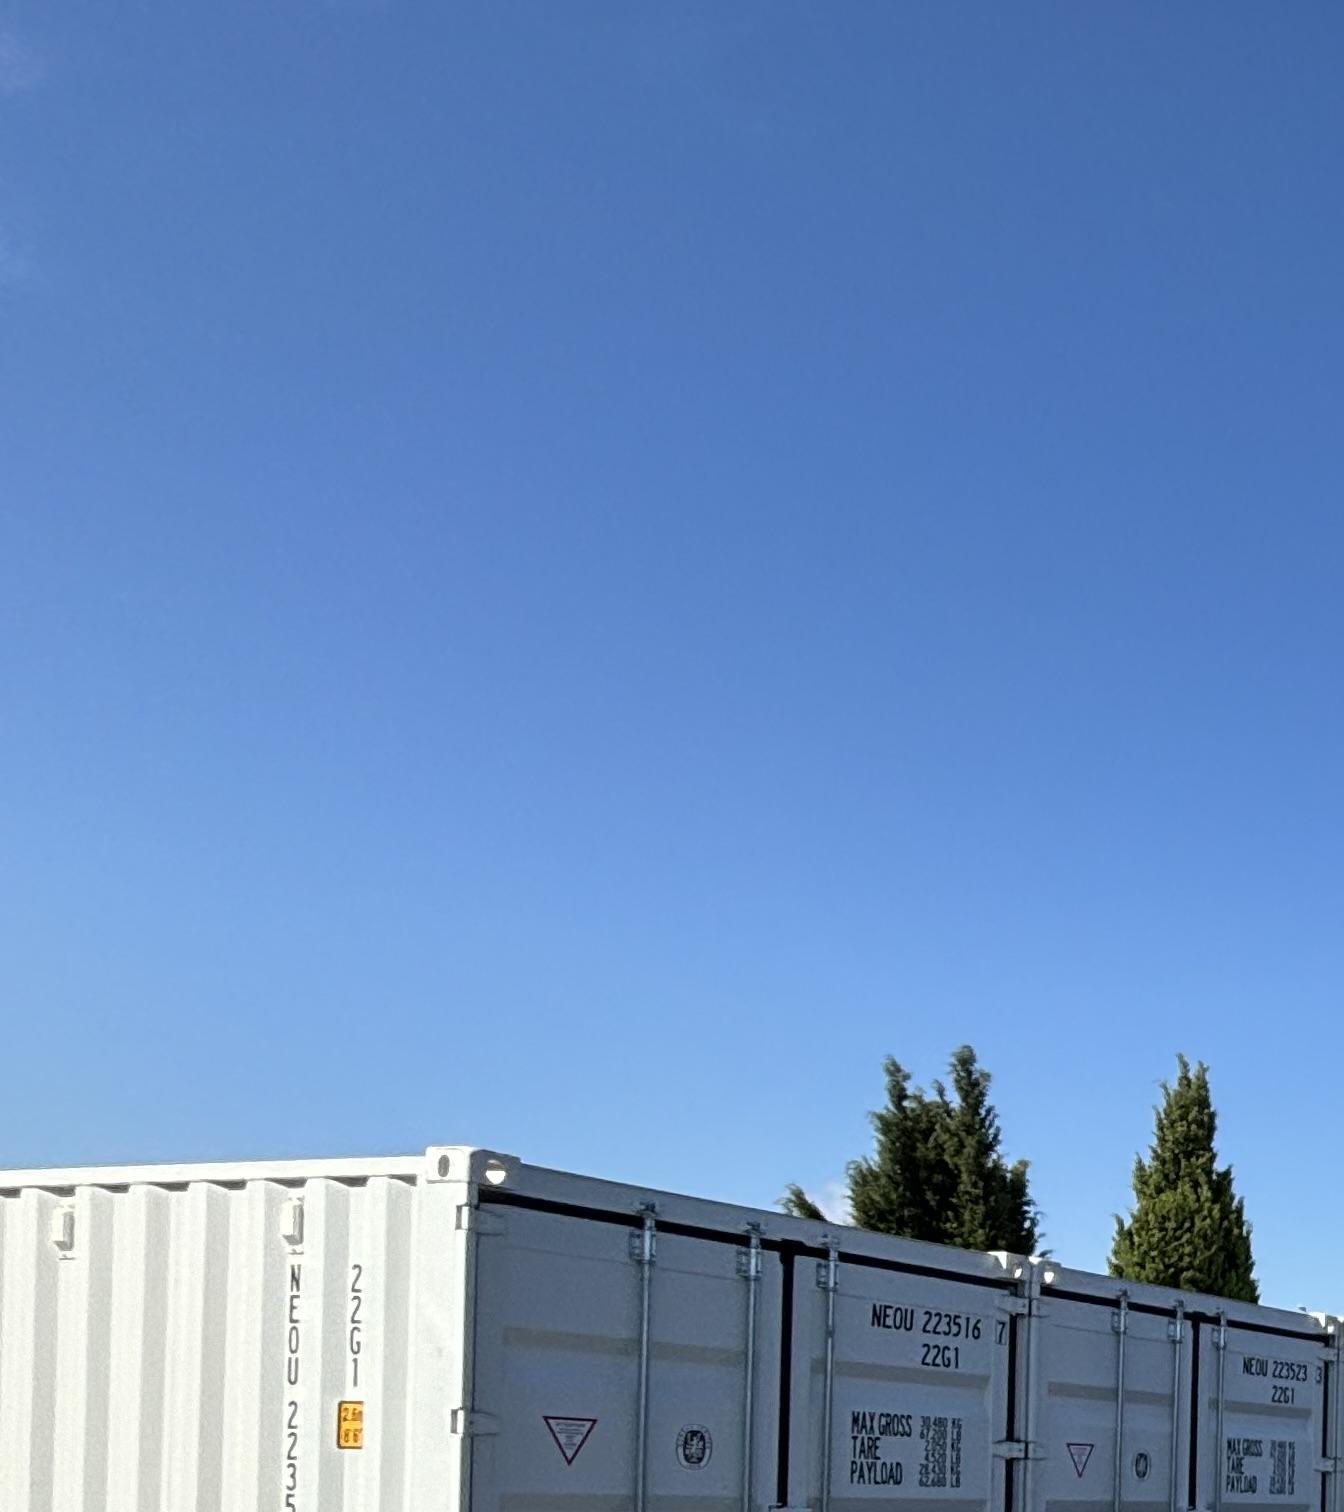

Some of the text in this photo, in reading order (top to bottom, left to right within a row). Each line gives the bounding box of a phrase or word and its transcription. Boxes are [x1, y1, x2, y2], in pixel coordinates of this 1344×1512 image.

[287, 1264, 301, 1385] NEOU
[350, 1264, 362, 1387] 22G1
[871, 1303, 1006, 1344] NEOU 223516 7
[921, 1344, 960, 1369] 22G1
[1243, 1356, 1268, 1377] NEOU
[1271, 1385, 1295, 1405] 22G1
[851, 1411, 912, 1437] MAX GROSS
[851, 1436, 881, 1460] TARE
[850, 1460, 903, 1485] PAYLOAD
